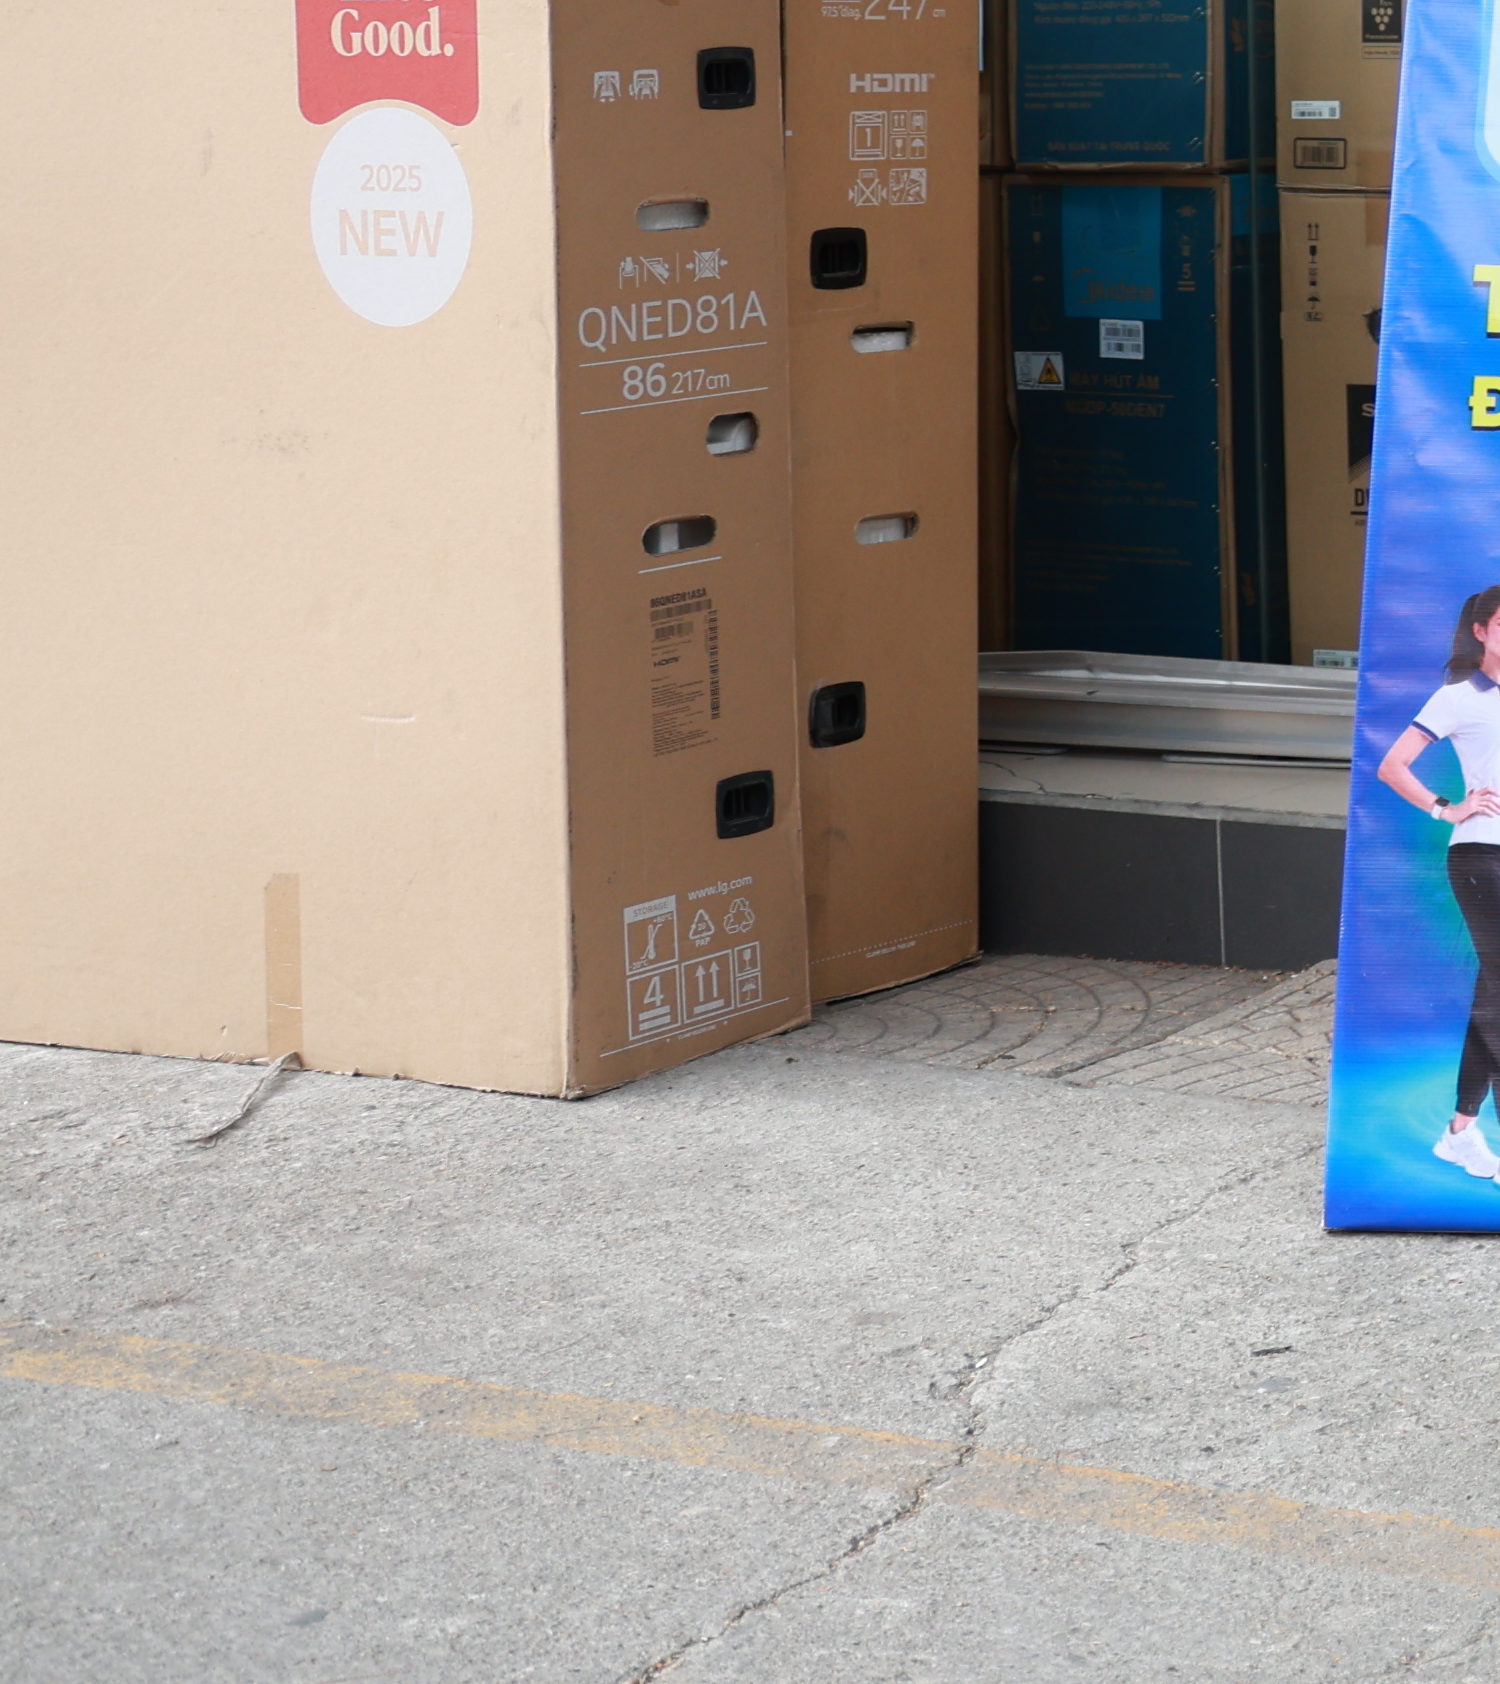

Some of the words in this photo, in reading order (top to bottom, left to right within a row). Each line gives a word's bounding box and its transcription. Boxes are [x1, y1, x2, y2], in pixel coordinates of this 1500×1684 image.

[330, 6, 454, 57] Good.
[850, 72, 935, 93] HDMI
[359, 164, 423, 193] 2025
[337, 209, 445, 259] NEW
[578, 290, 767, 352] QNED81A
[622, 362, 667, 400] 86
[671, 369, 730, 395] 217cm
[688, 876, 752, 901] www.lg.com
